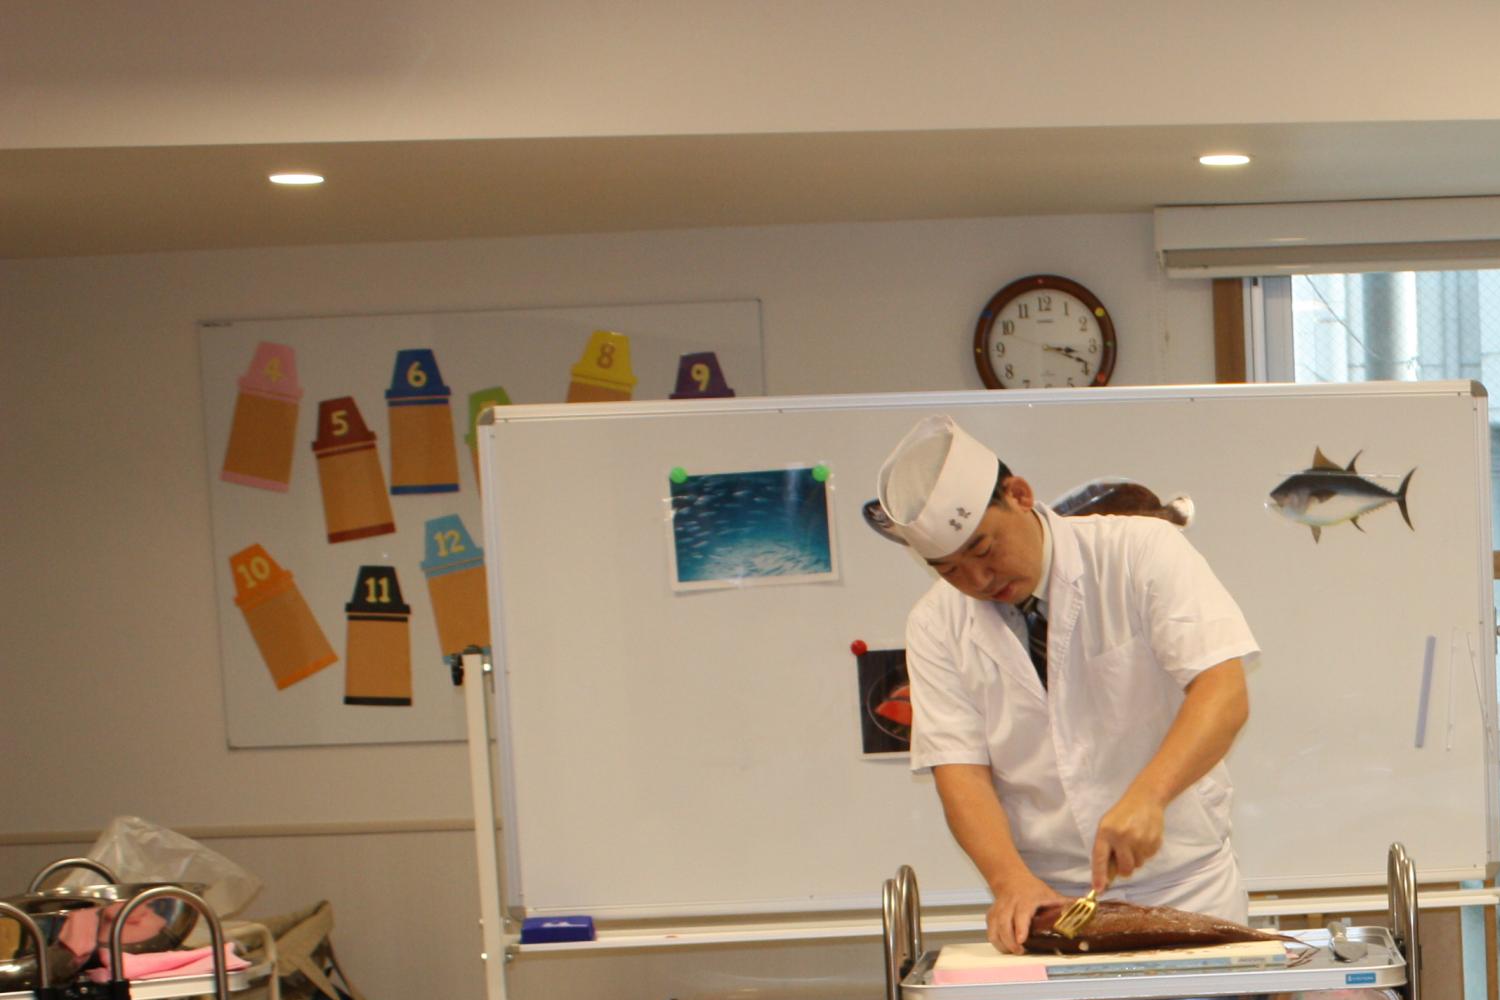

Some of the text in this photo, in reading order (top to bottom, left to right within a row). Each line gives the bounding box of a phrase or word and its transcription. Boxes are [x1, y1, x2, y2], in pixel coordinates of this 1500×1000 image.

[1018, 303, 1029, 319] 11
[1037, 296, 1052, 311] 12
[1064, 302, 1069, 316] 1
[1002, 320, 1015, 335] 10
[1078, 316, 1088, 332] 2
[597, 342, 616, 369] 8
[996, 342, 1005, 358] 9
[1088, 338, 1097, 354] 3
[263, 356, 285, 382] 4
[406, 361, 427, 387] 6
[690, 363, 712, 392] 9
[1005, 364, 1014, 379] 8
[330, 410, 349, 436] 5
[433, 530, 465, 557] 12
[236, 555, 271, 589] 10
[365, 576, 391, 603] 11
